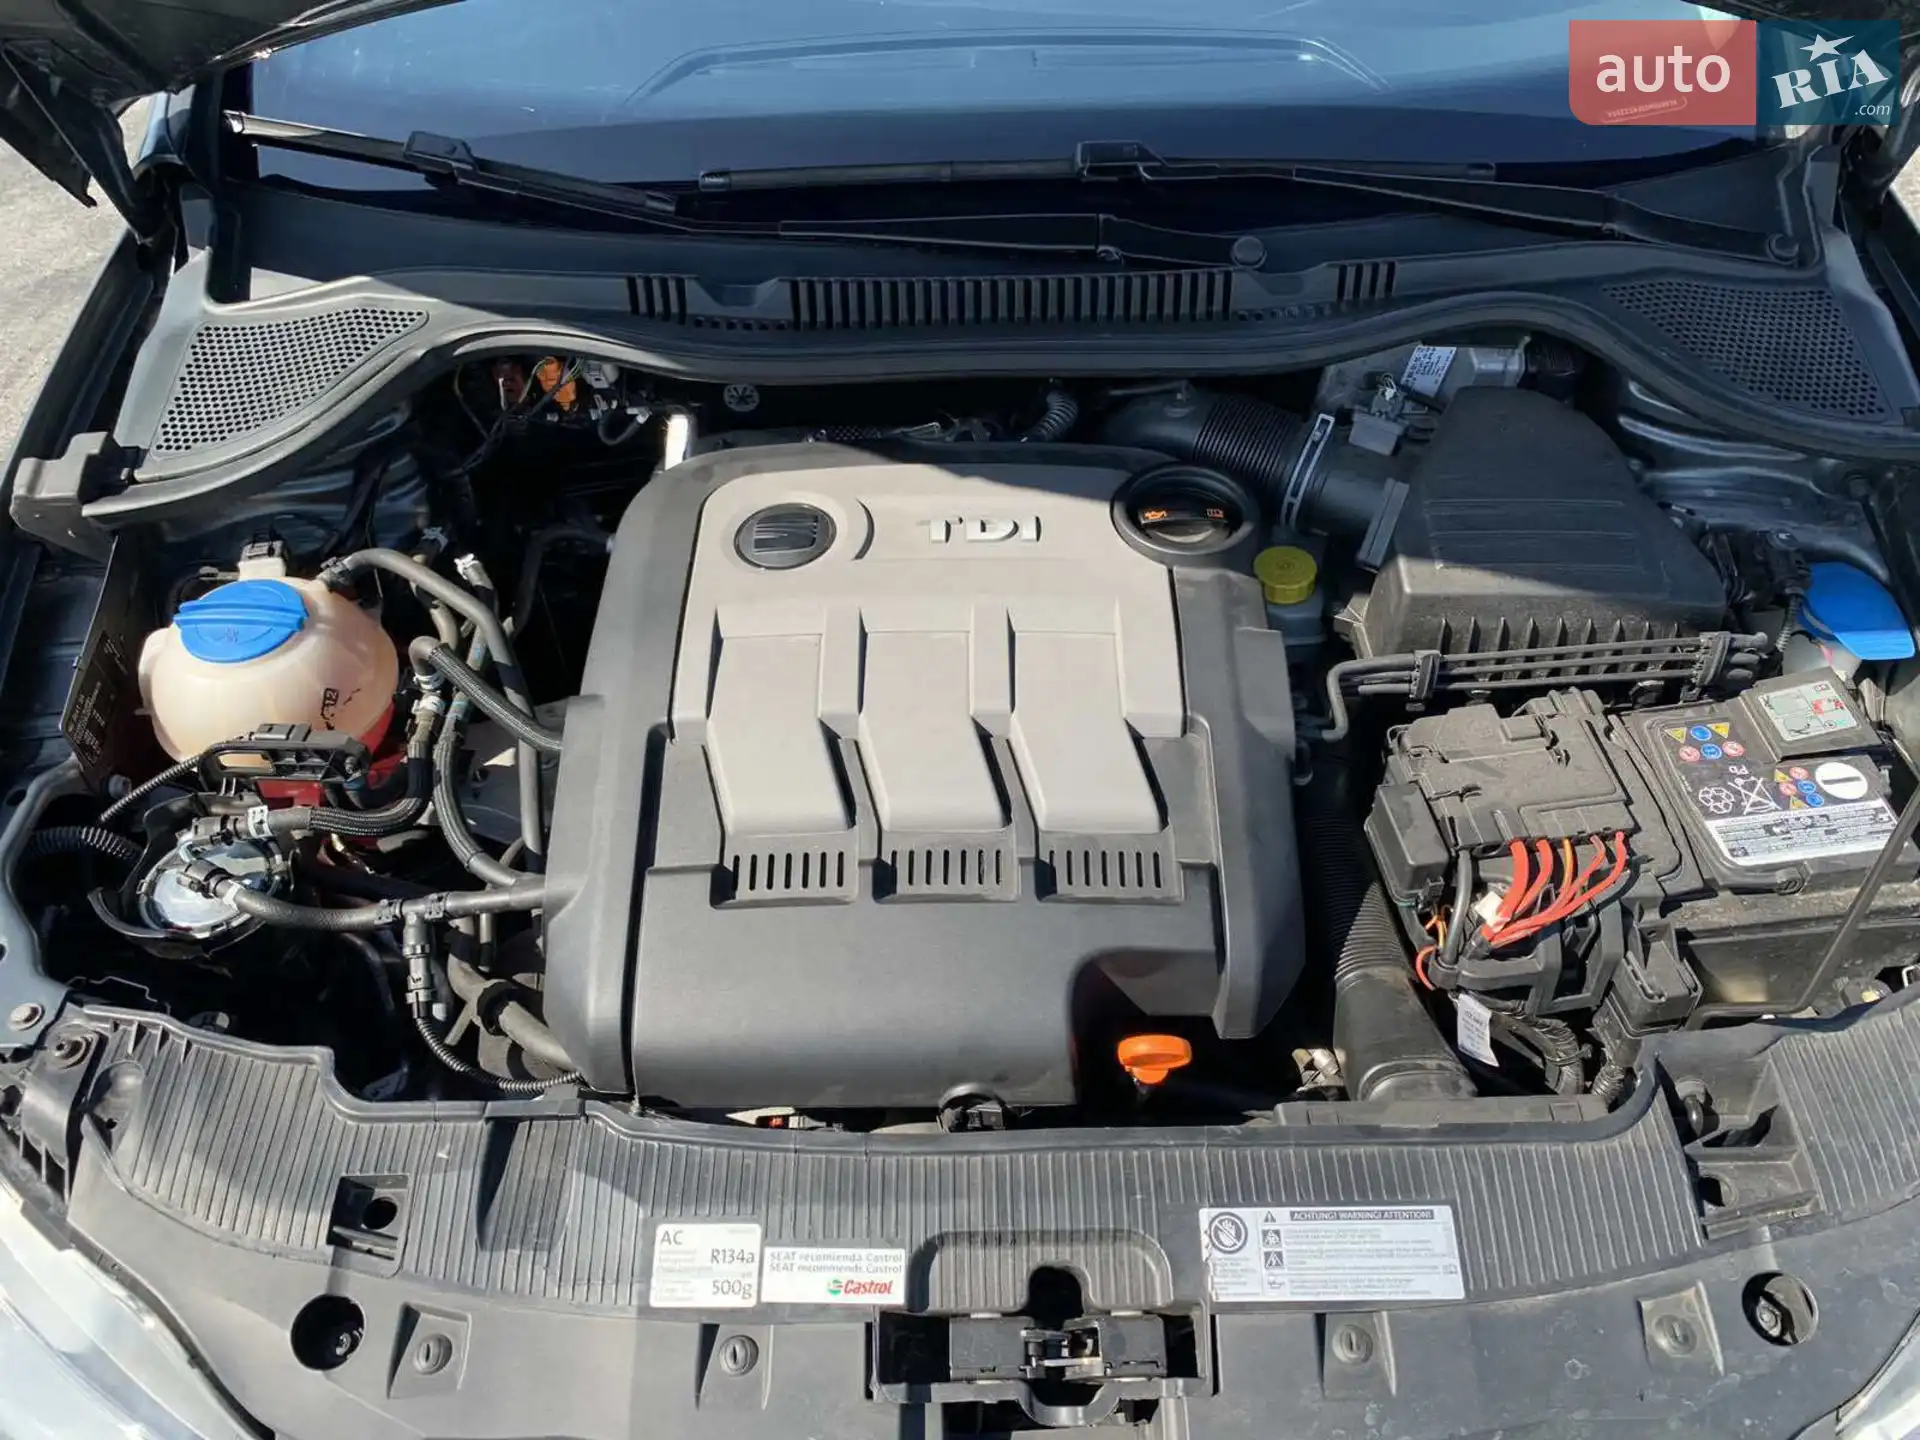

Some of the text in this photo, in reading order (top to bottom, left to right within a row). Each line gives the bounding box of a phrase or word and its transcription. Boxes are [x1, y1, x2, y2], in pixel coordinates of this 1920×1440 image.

[918, 515, 1042, 544] TDI
[1293, 1210, 1433, 1220] ACHTUNG! WARNING! ATTENTION!
[660, 1230, 684, 1246] AC
[710, 1248, 755, 1264] R134a
[769, 1251, 903, 1263] SEAT recomienda Castrol
[769, 1263, 902, 1274] SEAT recommends Castrol
[711, 1278, 753, 1300] 500g
[844, 1279, 893, 1295] Castrol
